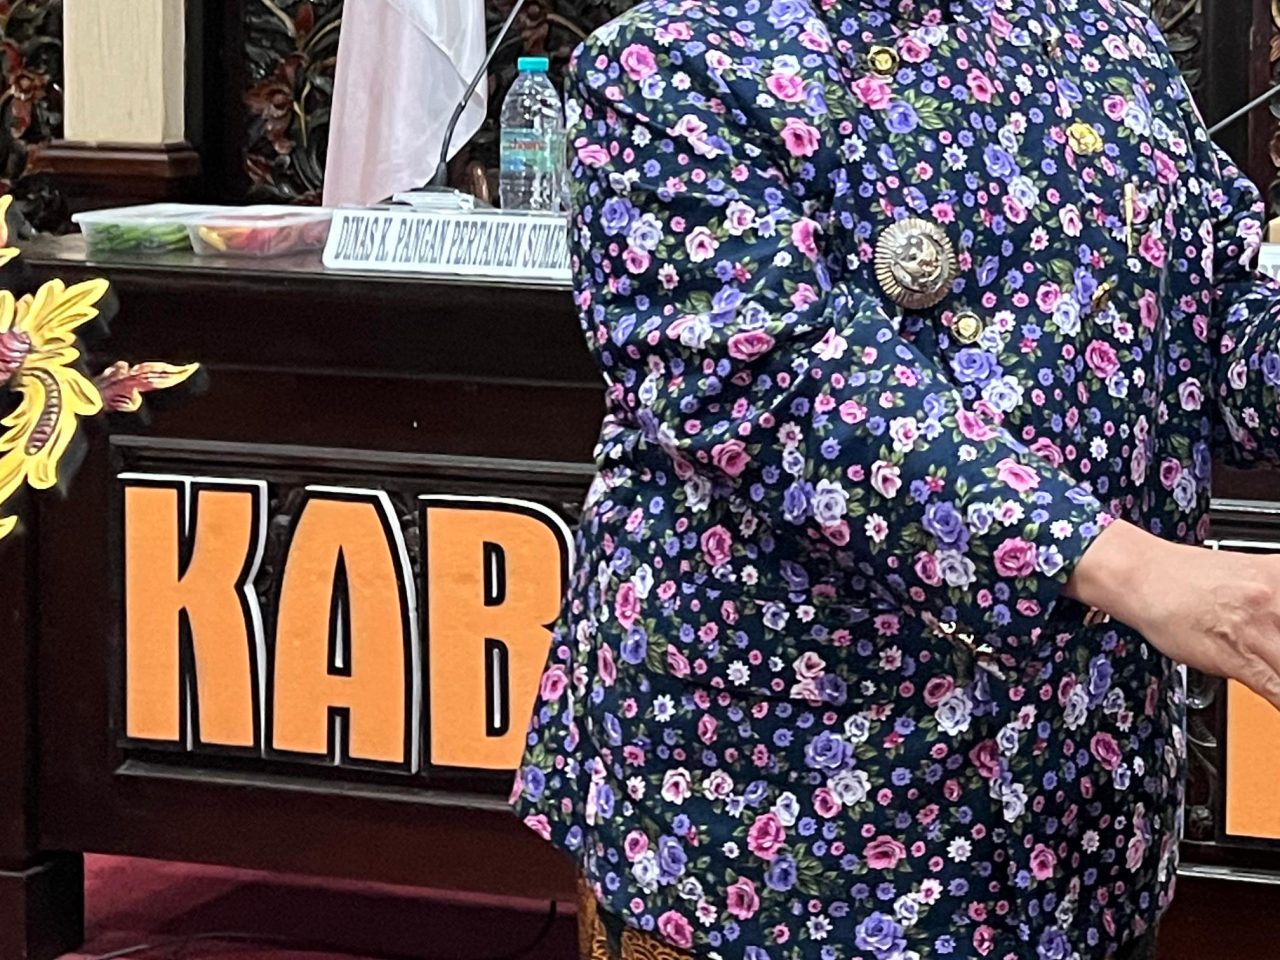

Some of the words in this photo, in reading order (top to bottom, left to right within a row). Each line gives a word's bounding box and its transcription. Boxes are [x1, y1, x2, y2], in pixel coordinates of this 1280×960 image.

[334, 215, 379, 261] DINAS
[375, 217, 393, 262] K.
[391, 218, 451, 265] PANGAN
[446, 220, 527, 268] PERTANIAN
